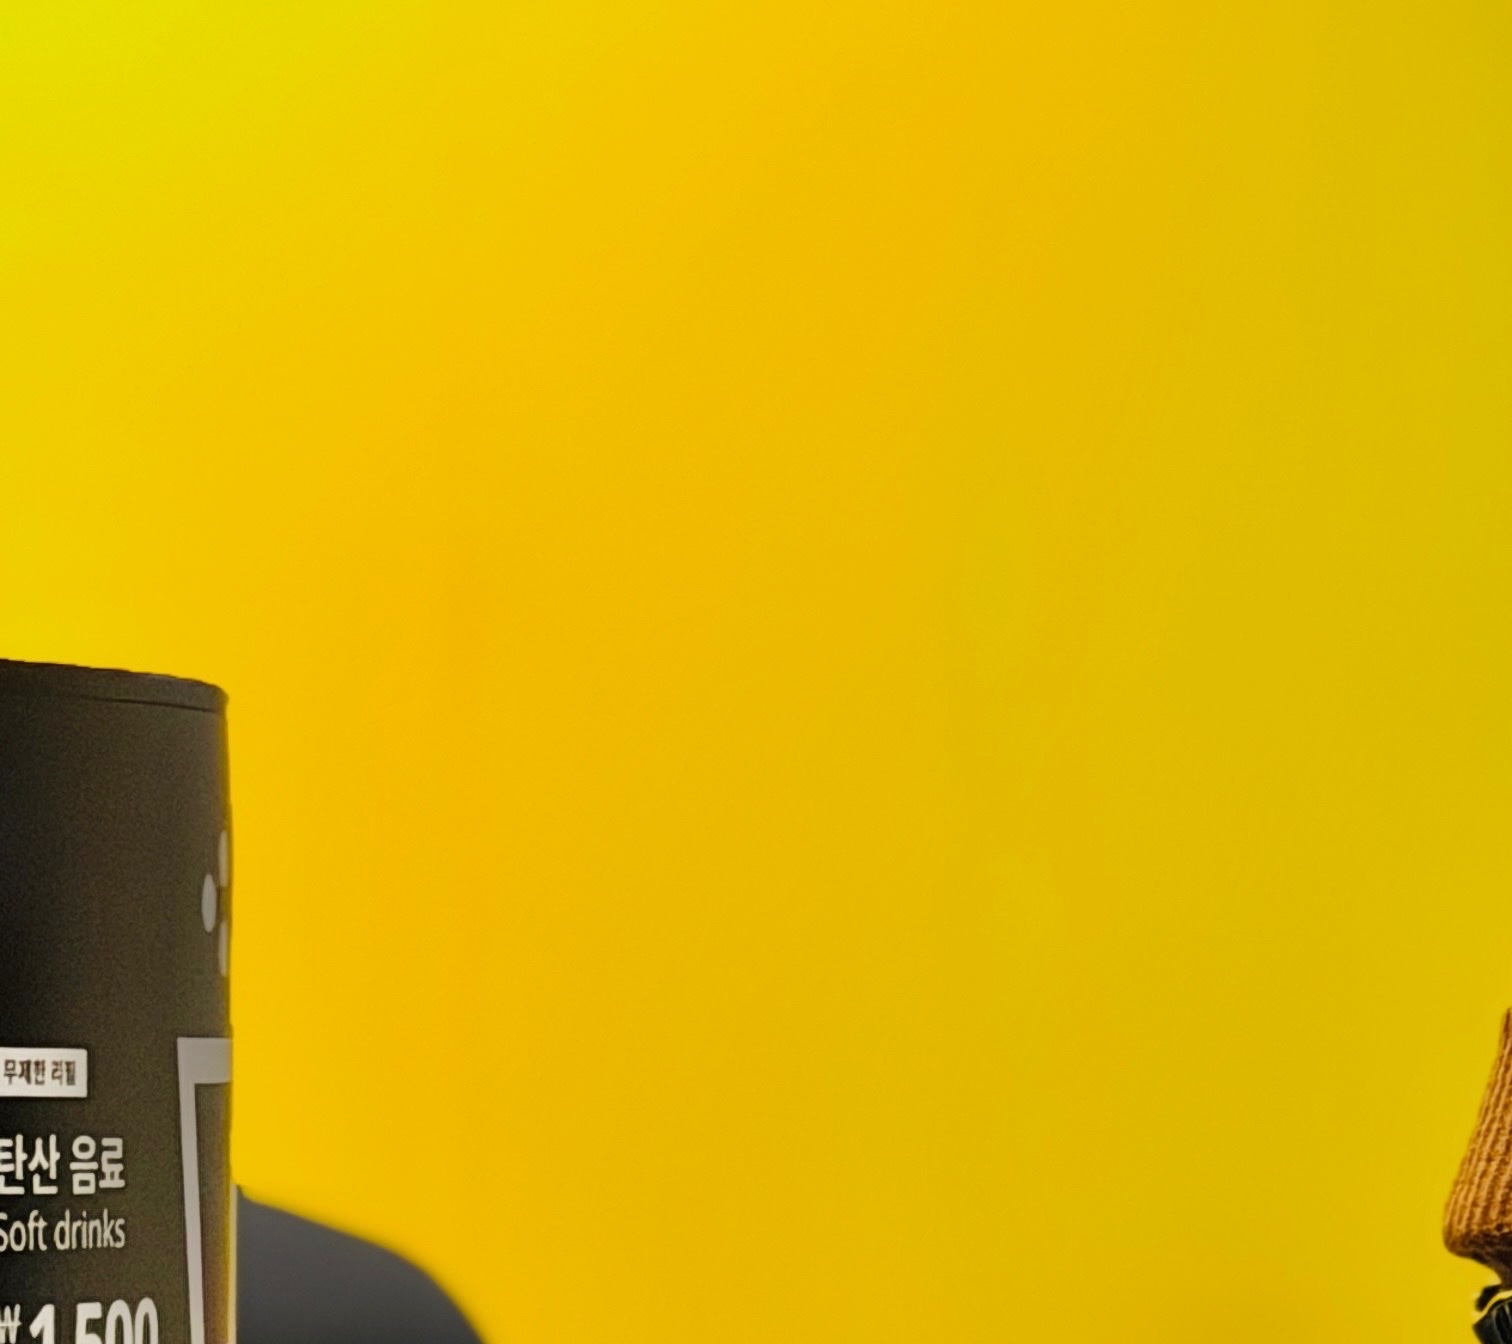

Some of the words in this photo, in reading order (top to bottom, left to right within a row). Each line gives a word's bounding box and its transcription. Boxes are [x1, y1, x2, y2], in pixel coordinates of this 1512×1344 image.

[0, 1134, 61, 1195] 탄산
[69, 1135, 126, 1195] 음료
[53, 1208, 126, 1250] drinks
